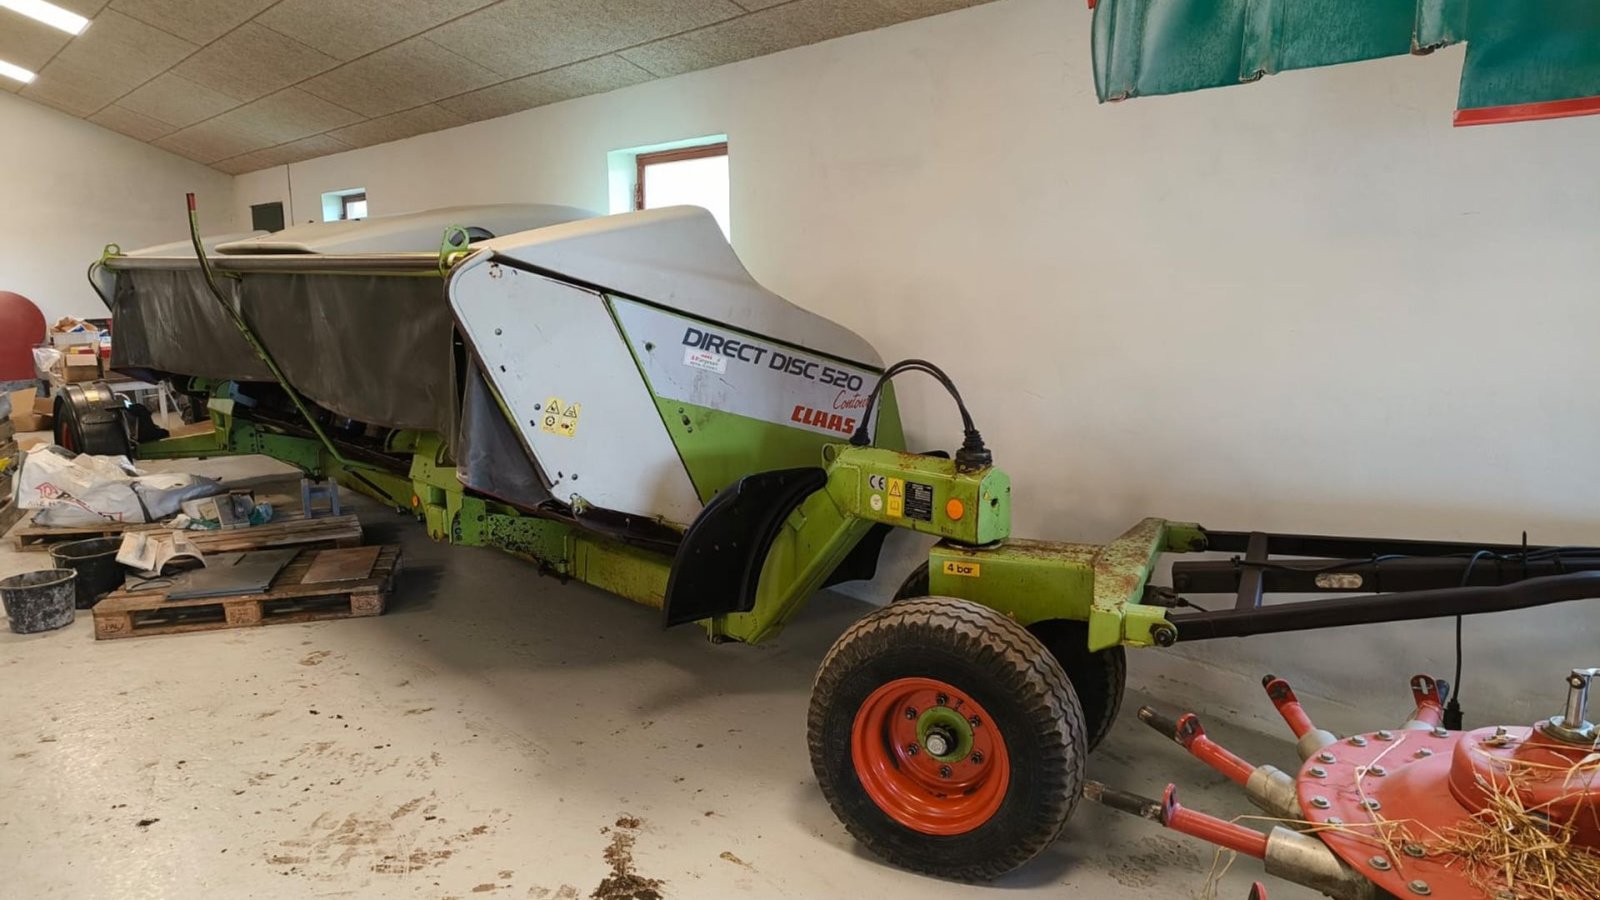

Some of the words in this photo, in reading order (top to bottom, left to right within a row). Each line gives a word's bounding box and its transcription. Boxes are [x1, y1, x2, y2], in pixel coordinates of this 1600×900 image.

[682, 327, 767, 364] DIRECT
[768, 352, 818, 380] DISC
[819, 366, 863, 391] 520
[791, 405, 856, 434] CLAAS
[869, 474, 885, 491] CE
[947, 563, 954, 572] 4
[957, 564, 973, 574] bar
